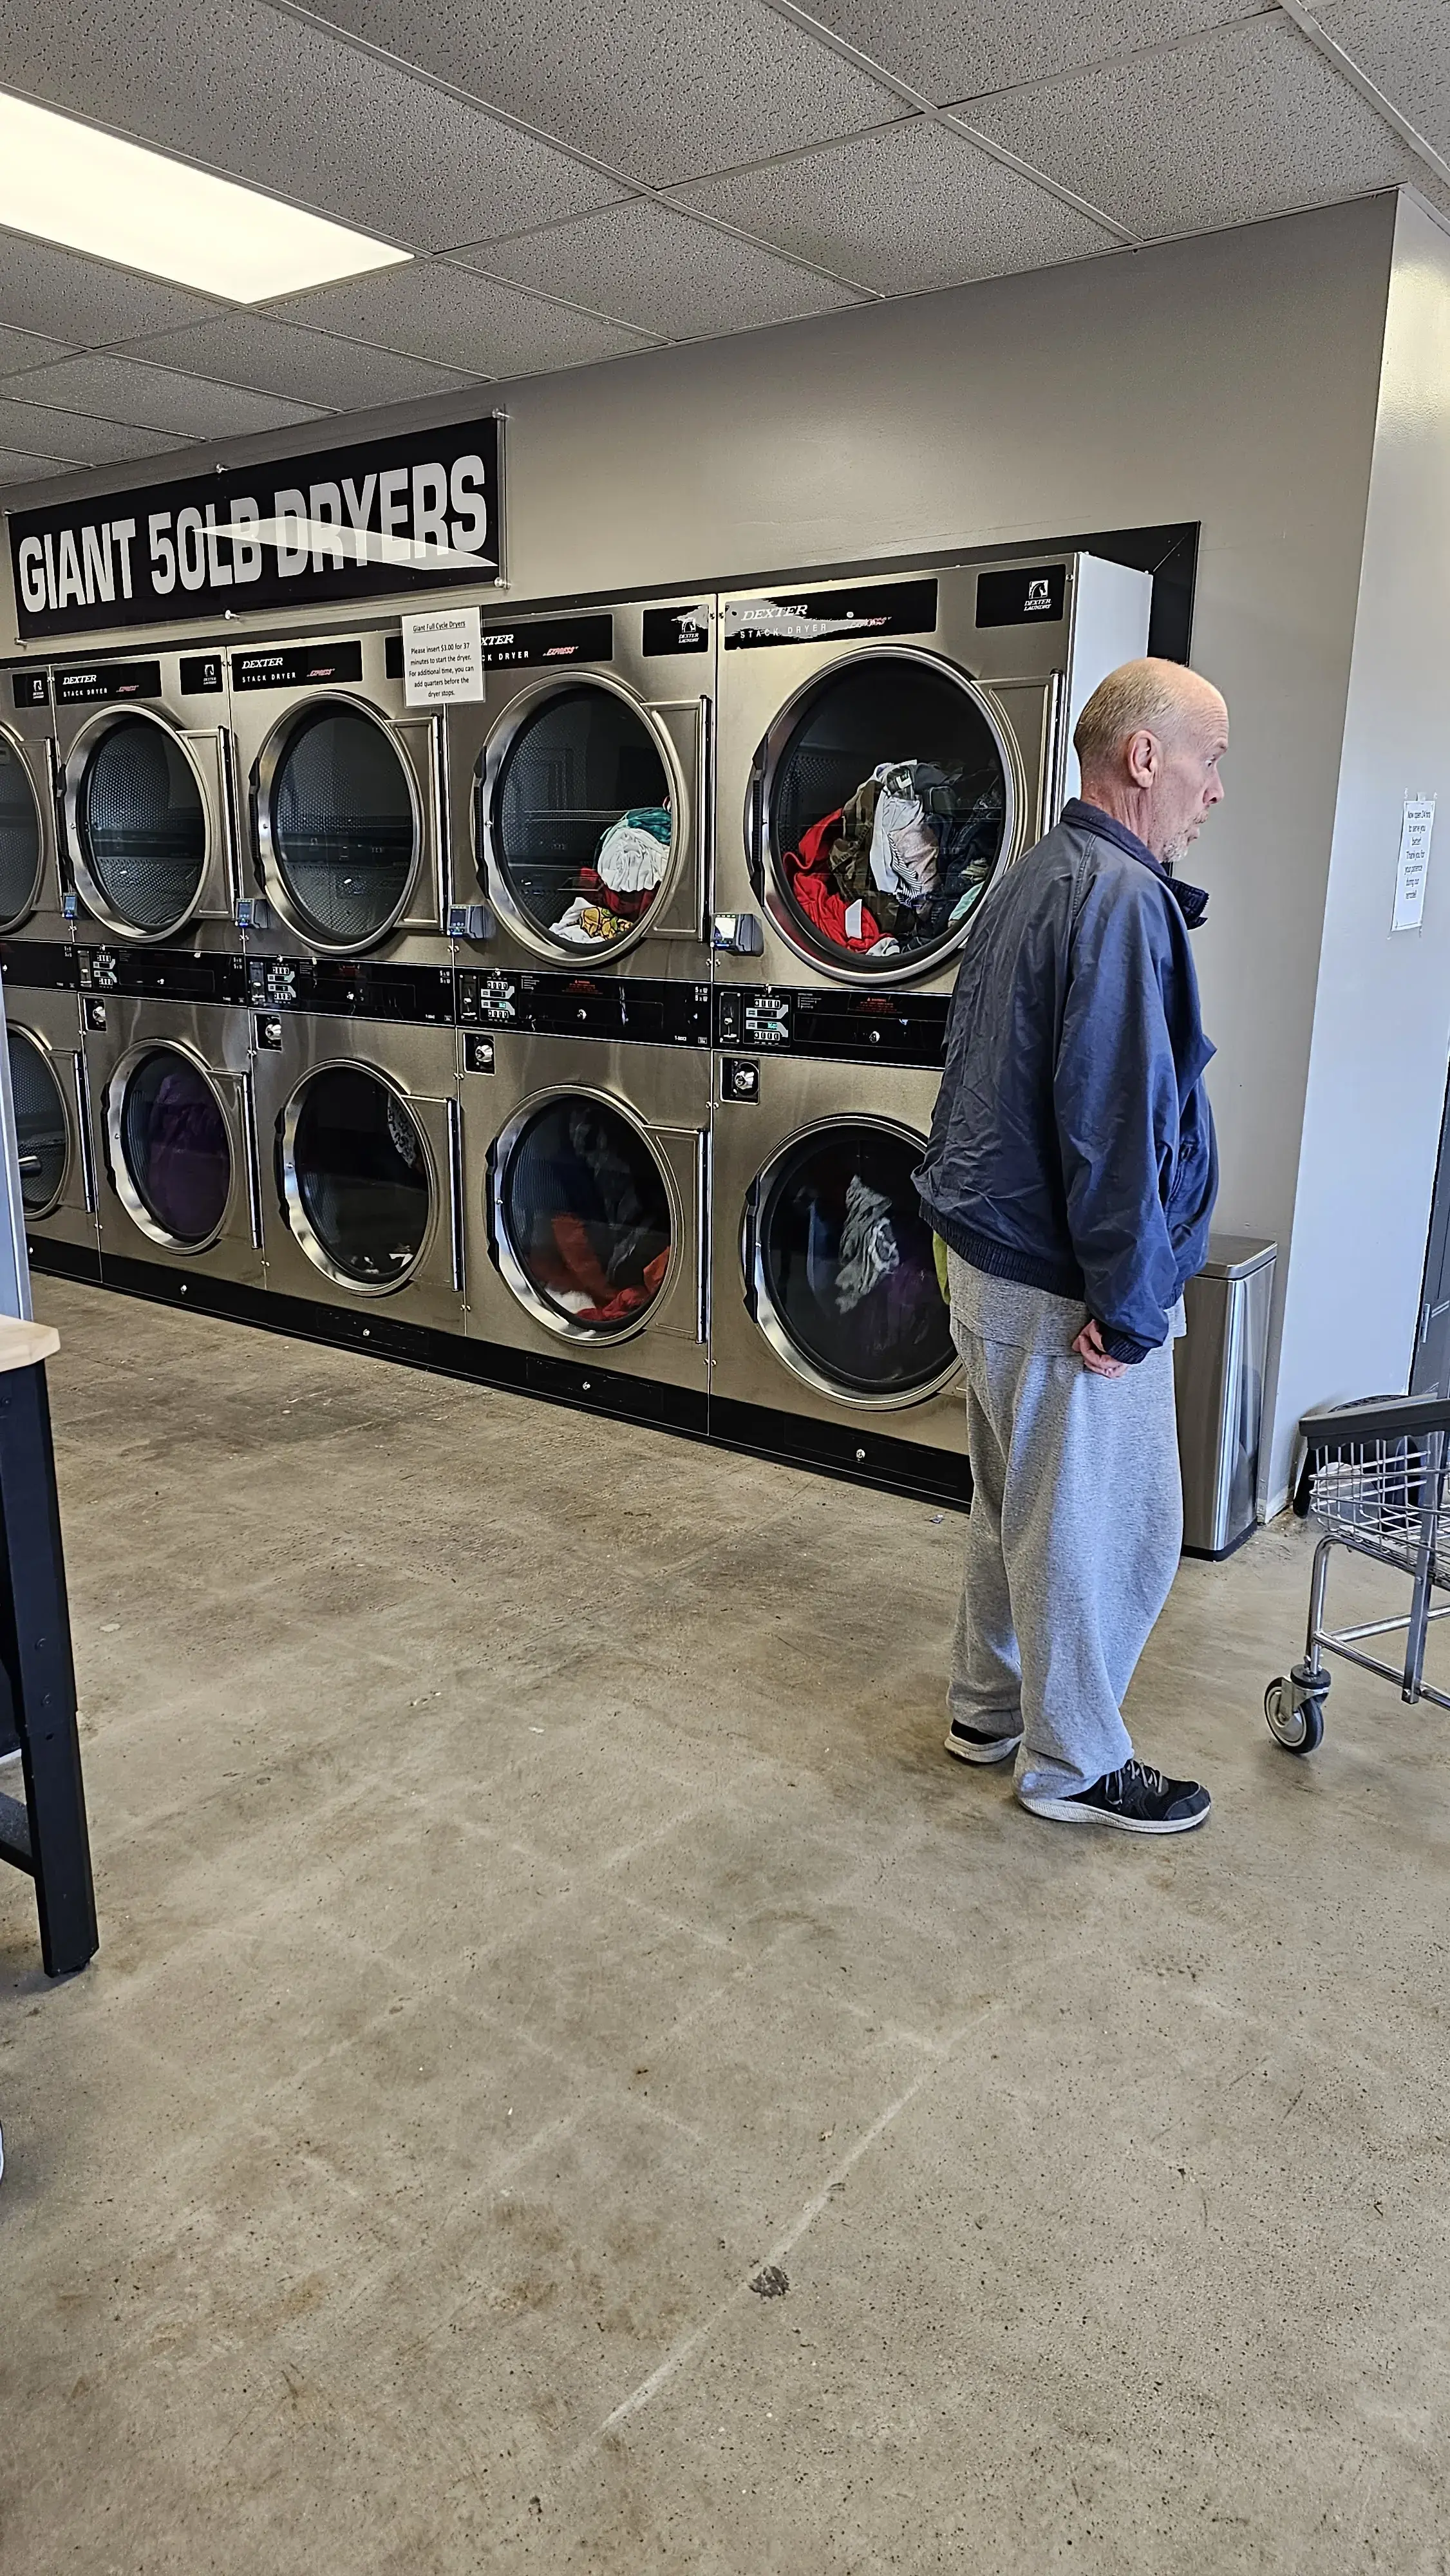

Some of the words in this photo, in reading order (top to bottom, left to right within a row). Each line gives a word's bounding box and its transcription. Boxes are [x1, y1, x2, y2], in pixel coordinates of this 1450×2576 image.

[19, 517, 136, 613] GIANT
[147, 497, 263, 594] 50LB
[274, 455, 487, 578] DRYERS
[740, 605, 808, 621] DEXTER
[435, 621, 447, 630] Cycle
[740, 627, 780, 639] STACK
[787, 623, 826, 634] DRYER
[481, 634, 514, 646] XTER
[498, 651, 529, 661] DRYER
[241, 657, 283, 669] DEXTER
[242, 674, 267, 683] STACK
[271, 672, 296, 681] DRYER
[417, 668, 440, 676] additional
[62, 674, 97, 685] DEXTER
[424, 679, 443, 688] quarters
